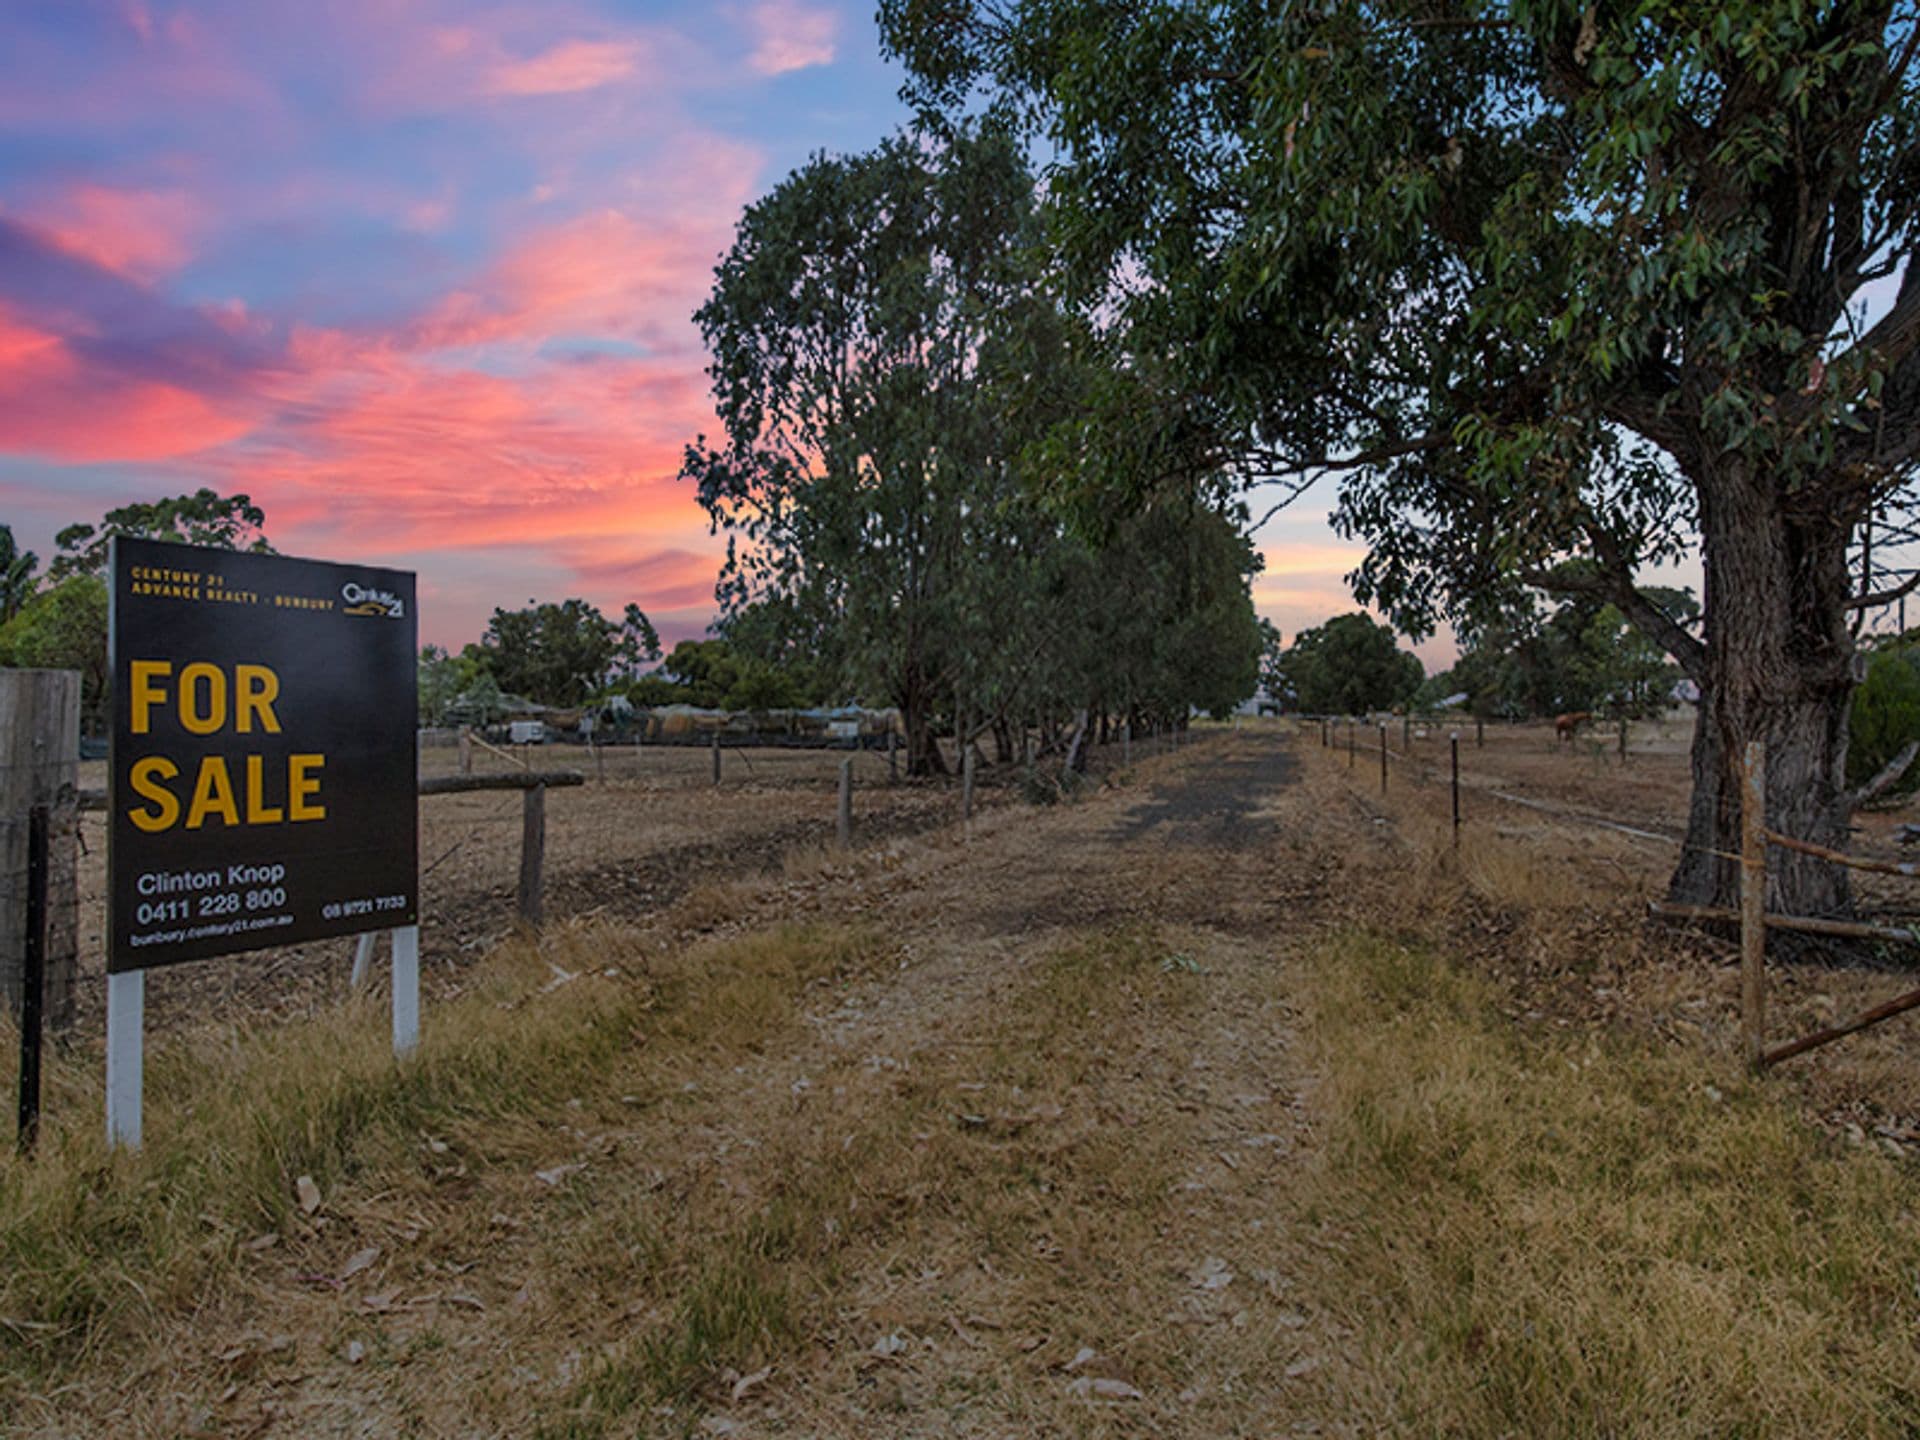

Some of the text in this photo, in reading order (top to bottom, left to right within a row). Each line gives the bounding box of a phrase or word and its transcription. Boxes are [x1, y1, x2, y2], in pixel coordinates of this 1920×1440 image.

[131, 566, 223, 586] CENTURY 21
[131, 582, 200, 600] ADVANCE
[207, 588, 257, 605] REALTY
[130, 660, 282, 734] FOR
[128, 753, 326, 832] SALE
[137, 864, 285, 895] Clinton Knop
[136, 887, 286, 925] 0411 228 800
